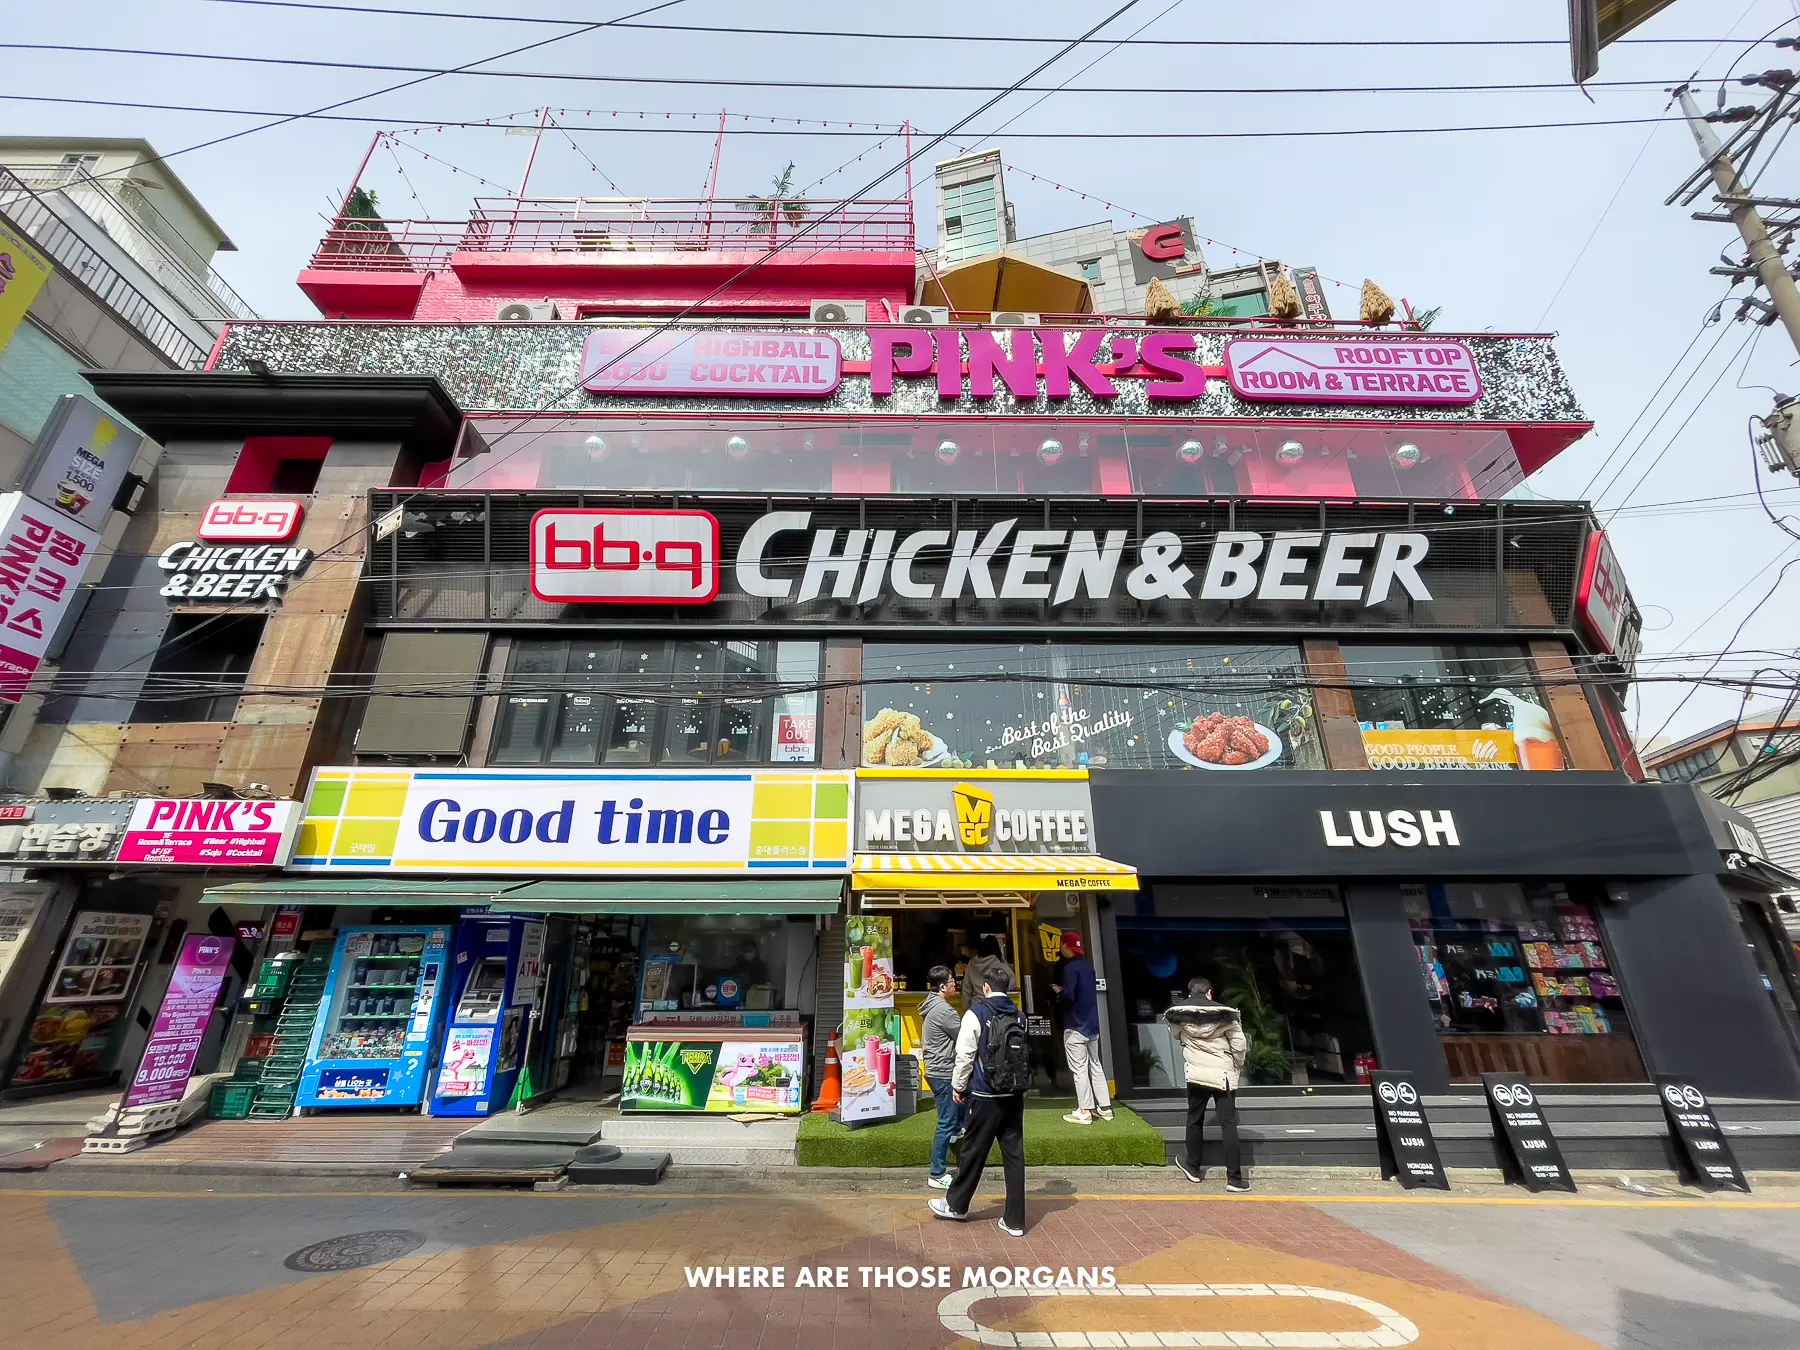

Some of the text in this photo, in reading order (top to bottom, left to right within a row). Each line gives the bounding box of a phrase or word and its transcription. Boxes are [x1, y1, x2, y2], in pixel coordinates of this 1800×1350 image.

[691, 338, 830, 359] HIGHBALL
[1335, 347, 1463, 366] ROOFTOP
[690, 363, 828, 384] COCKTAIL
[867, 329, 1207, 401] PINK'S
[1241, 372, 1320, 391] ROOM
[1346, 372, 1471, 393] TERRACE
[71, 455, 104, 480] SIZE
[76, 447, 105, 470] MEGA
[158, 541, 312, 573] CHICKEN
[783, 719, 815, 729] TAKE
[1002, 707, 1091, 746] Best of the
[1032, 710, 1134, 758] Best Quality
[785, 730, 811, 740] OUT
[1365, 744, 1459, 755] GOOD PEOPLE
[1368, 755, 1420, 770] GOOD
[1421, 756, 1472, 770] BEER
[146, 801, 275, 831] PINK'S
[417, 797, 730, 845] Good time
[865, 809, 1088, 842] MEGA COFFEE
[1319, 810, 1460, 847] LUSH
[1057, 879, 1112, 887] MEGA COFFEE
[520, 961, 540, 978] ATM
[1400, 1137, 1425, 1147] LUSH
[1521, 1140, 1548, 1149] LUSH
[1695, 1141, 1720, 1150] LUSH
